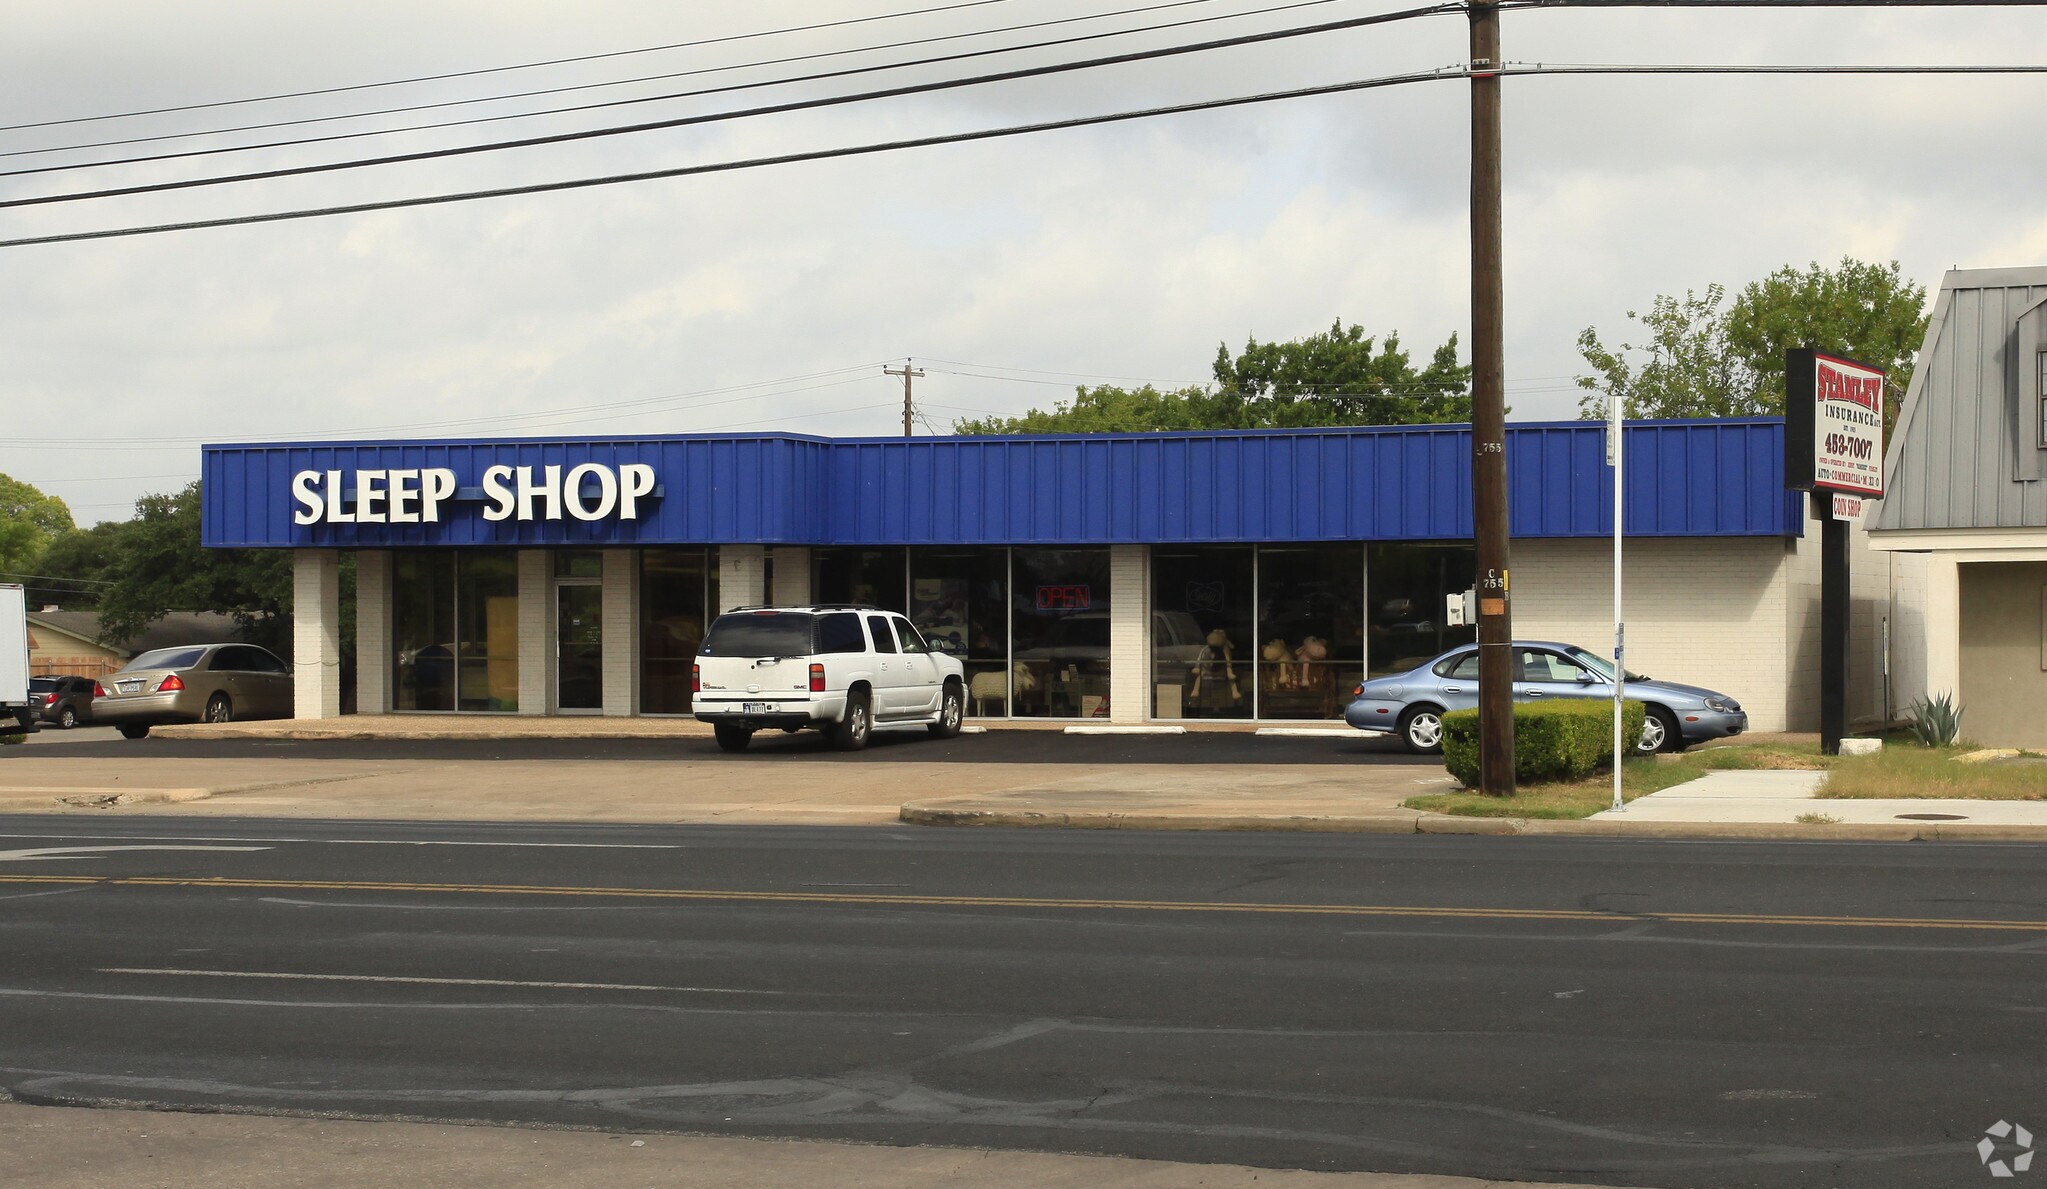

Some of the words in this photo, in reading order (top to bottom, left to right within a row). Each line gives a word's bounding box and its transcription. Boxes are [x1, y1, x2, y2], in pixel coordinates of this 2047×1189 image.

[1817, 362, 1881, 415] STANLEY
[1825, 404, 1873, 426] INSURANCE
[1825, 432, 1873, 461] 453-7007
[292, 469, 456, 525] SLEEP
[482, 463, 656, 521] SHOP
[1834, 497, 1846, 516] COIN
[1847, 499, 1861, 518] SHOP
[1483, 577, 1504, 589] 755
[1488, 568, 1495, 579] C
[1038, 586, 1089, 608] OPEN
